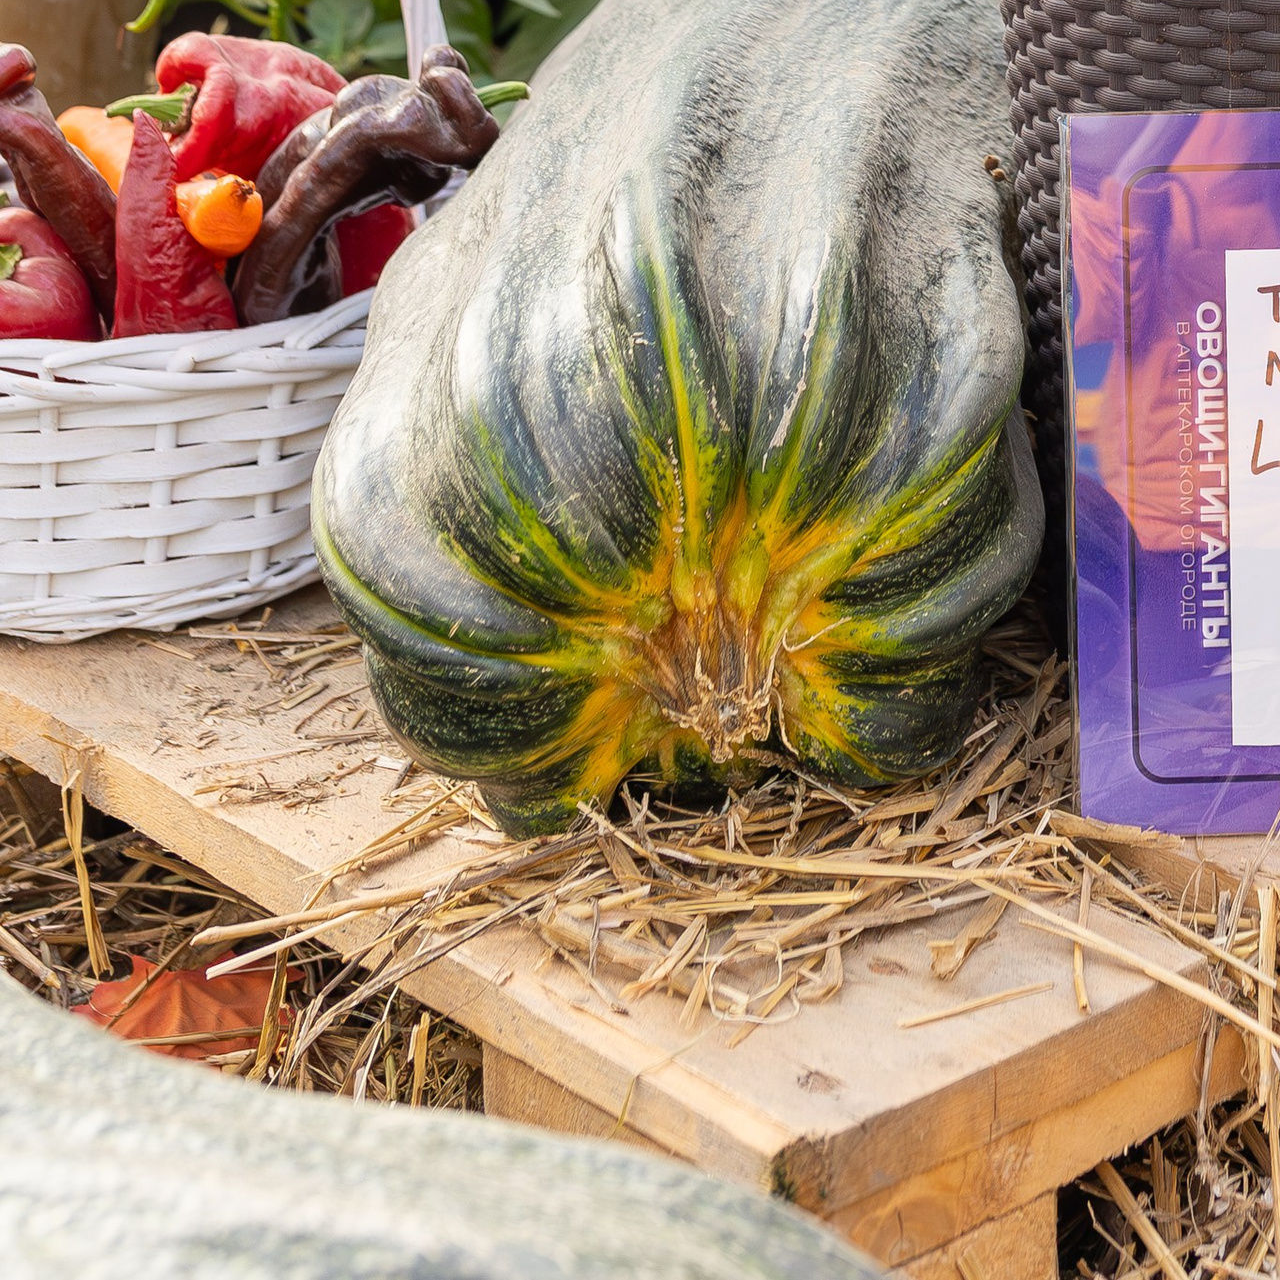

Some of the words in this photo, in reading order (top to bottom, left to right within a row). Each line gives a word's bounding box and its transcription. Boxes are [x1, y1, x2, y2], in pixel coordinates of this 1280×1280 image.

[1176, 321, 1190, 336] В
[1177, 343, 1194, 515] АПТЕКАРСКОМ
[1195, 301, 1231, 648] ОВОЩИ-ГИГАНТЫ
[1180, 524, 1197, 631] ОГОРОДЕ
